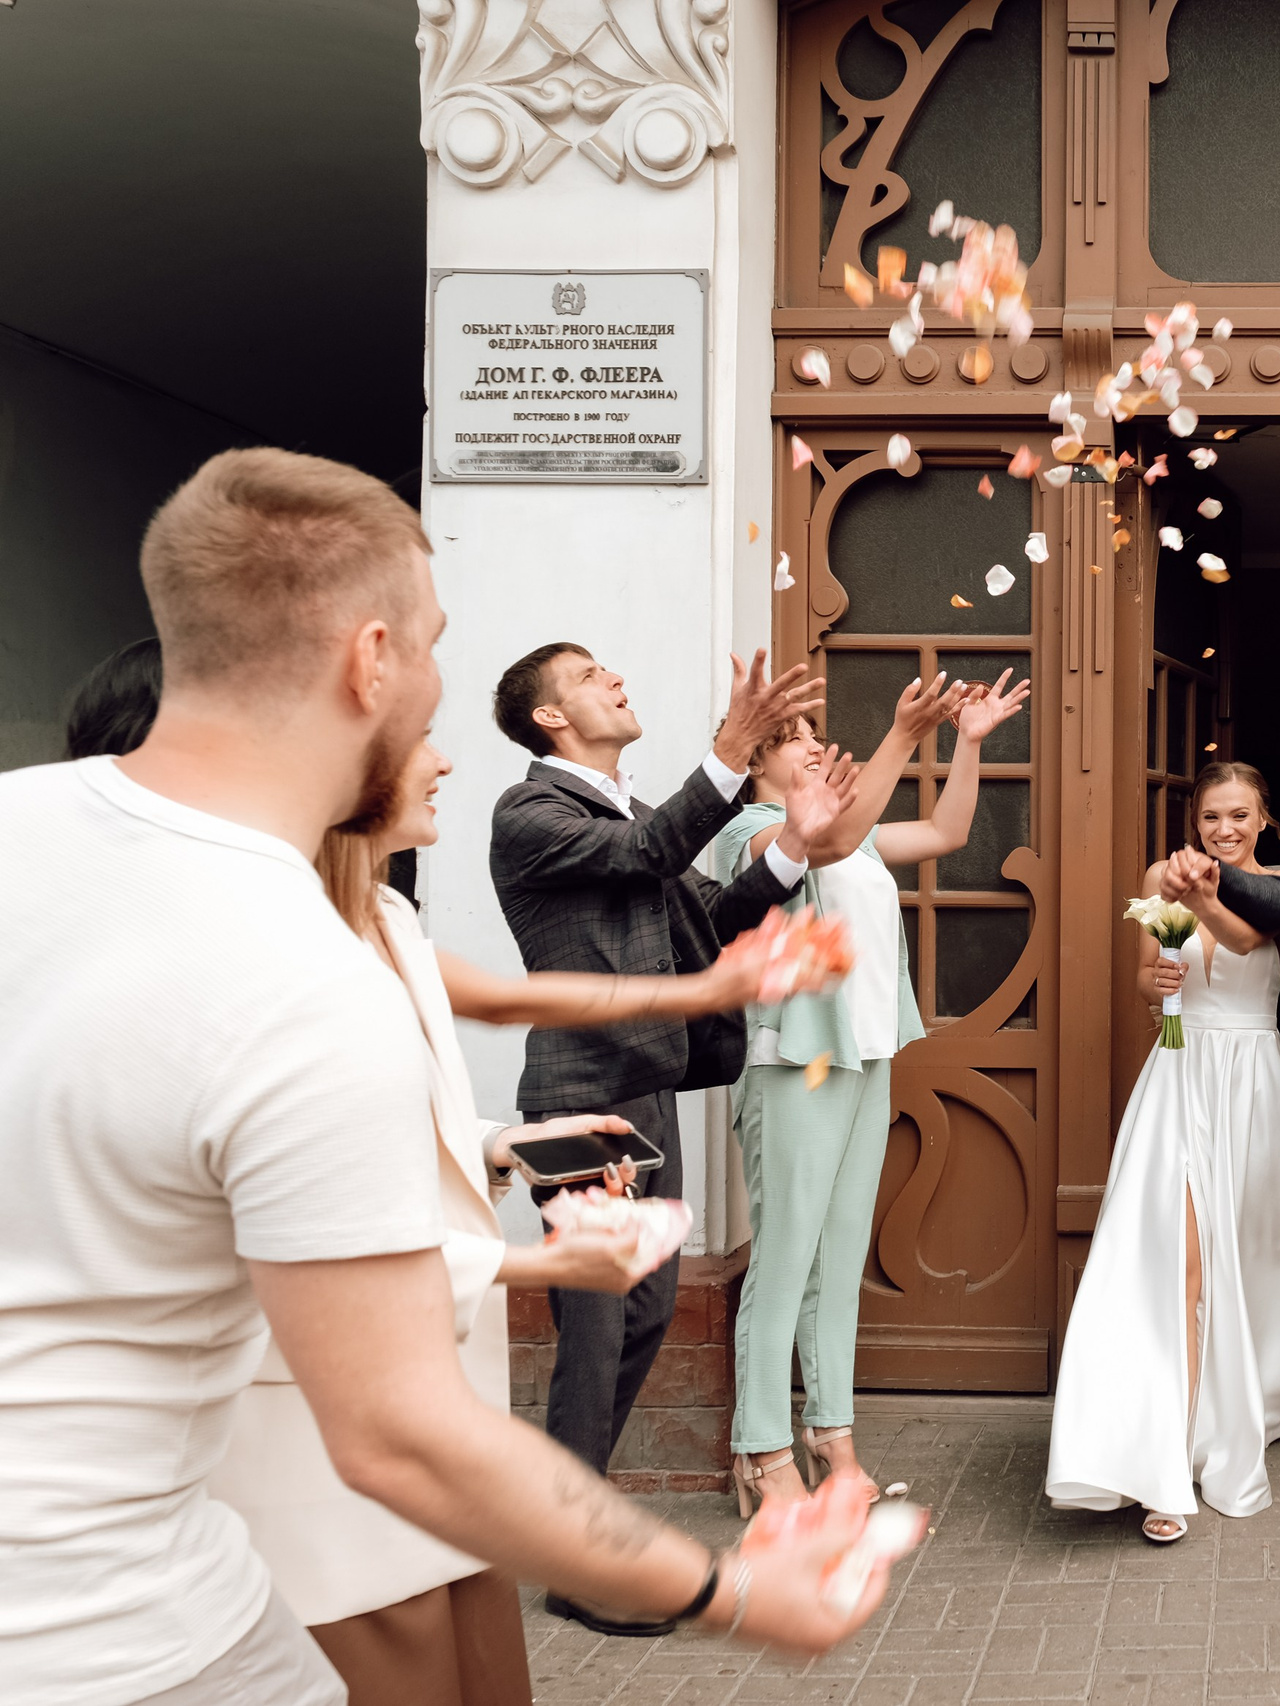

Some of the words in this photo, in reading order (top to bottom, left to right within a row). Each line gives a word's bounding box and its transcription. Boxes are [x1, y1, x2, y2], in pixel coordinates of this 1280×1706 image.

[462, 323, 512, 335] ОБЪЕКТ
[607, 324, 675, 336] НАСЛЕДИЯ
[488, 338, 589, 350] ФЕДЕРАЛЬНОГО
[592, 339, 658, 349] ЗНАЧЕНИЯ
[475, 367, 526, 386] ДОМ
[531, 367, 546, 383] Г.
[552, 367, 574, 383] Ф.
[580, 366, 664, 383] ФЛЕЕРА
[460, 390, 509, 401] (ЗДАНИЕ
[611, 389, 678, 400] МАГАЗИНА)
[513, 412, 570, 421] ПОСТРОЕНО
[574, 413, 580, 421] В
[584, 413, 600, 421] 1900
[605, 412, 630, 422] ГОДУ
[455, 433, 520, 444] ПОДЛЕЖИТ
[522, 432, 636, 445] ГОСУДАРСТВЕННОЙ
